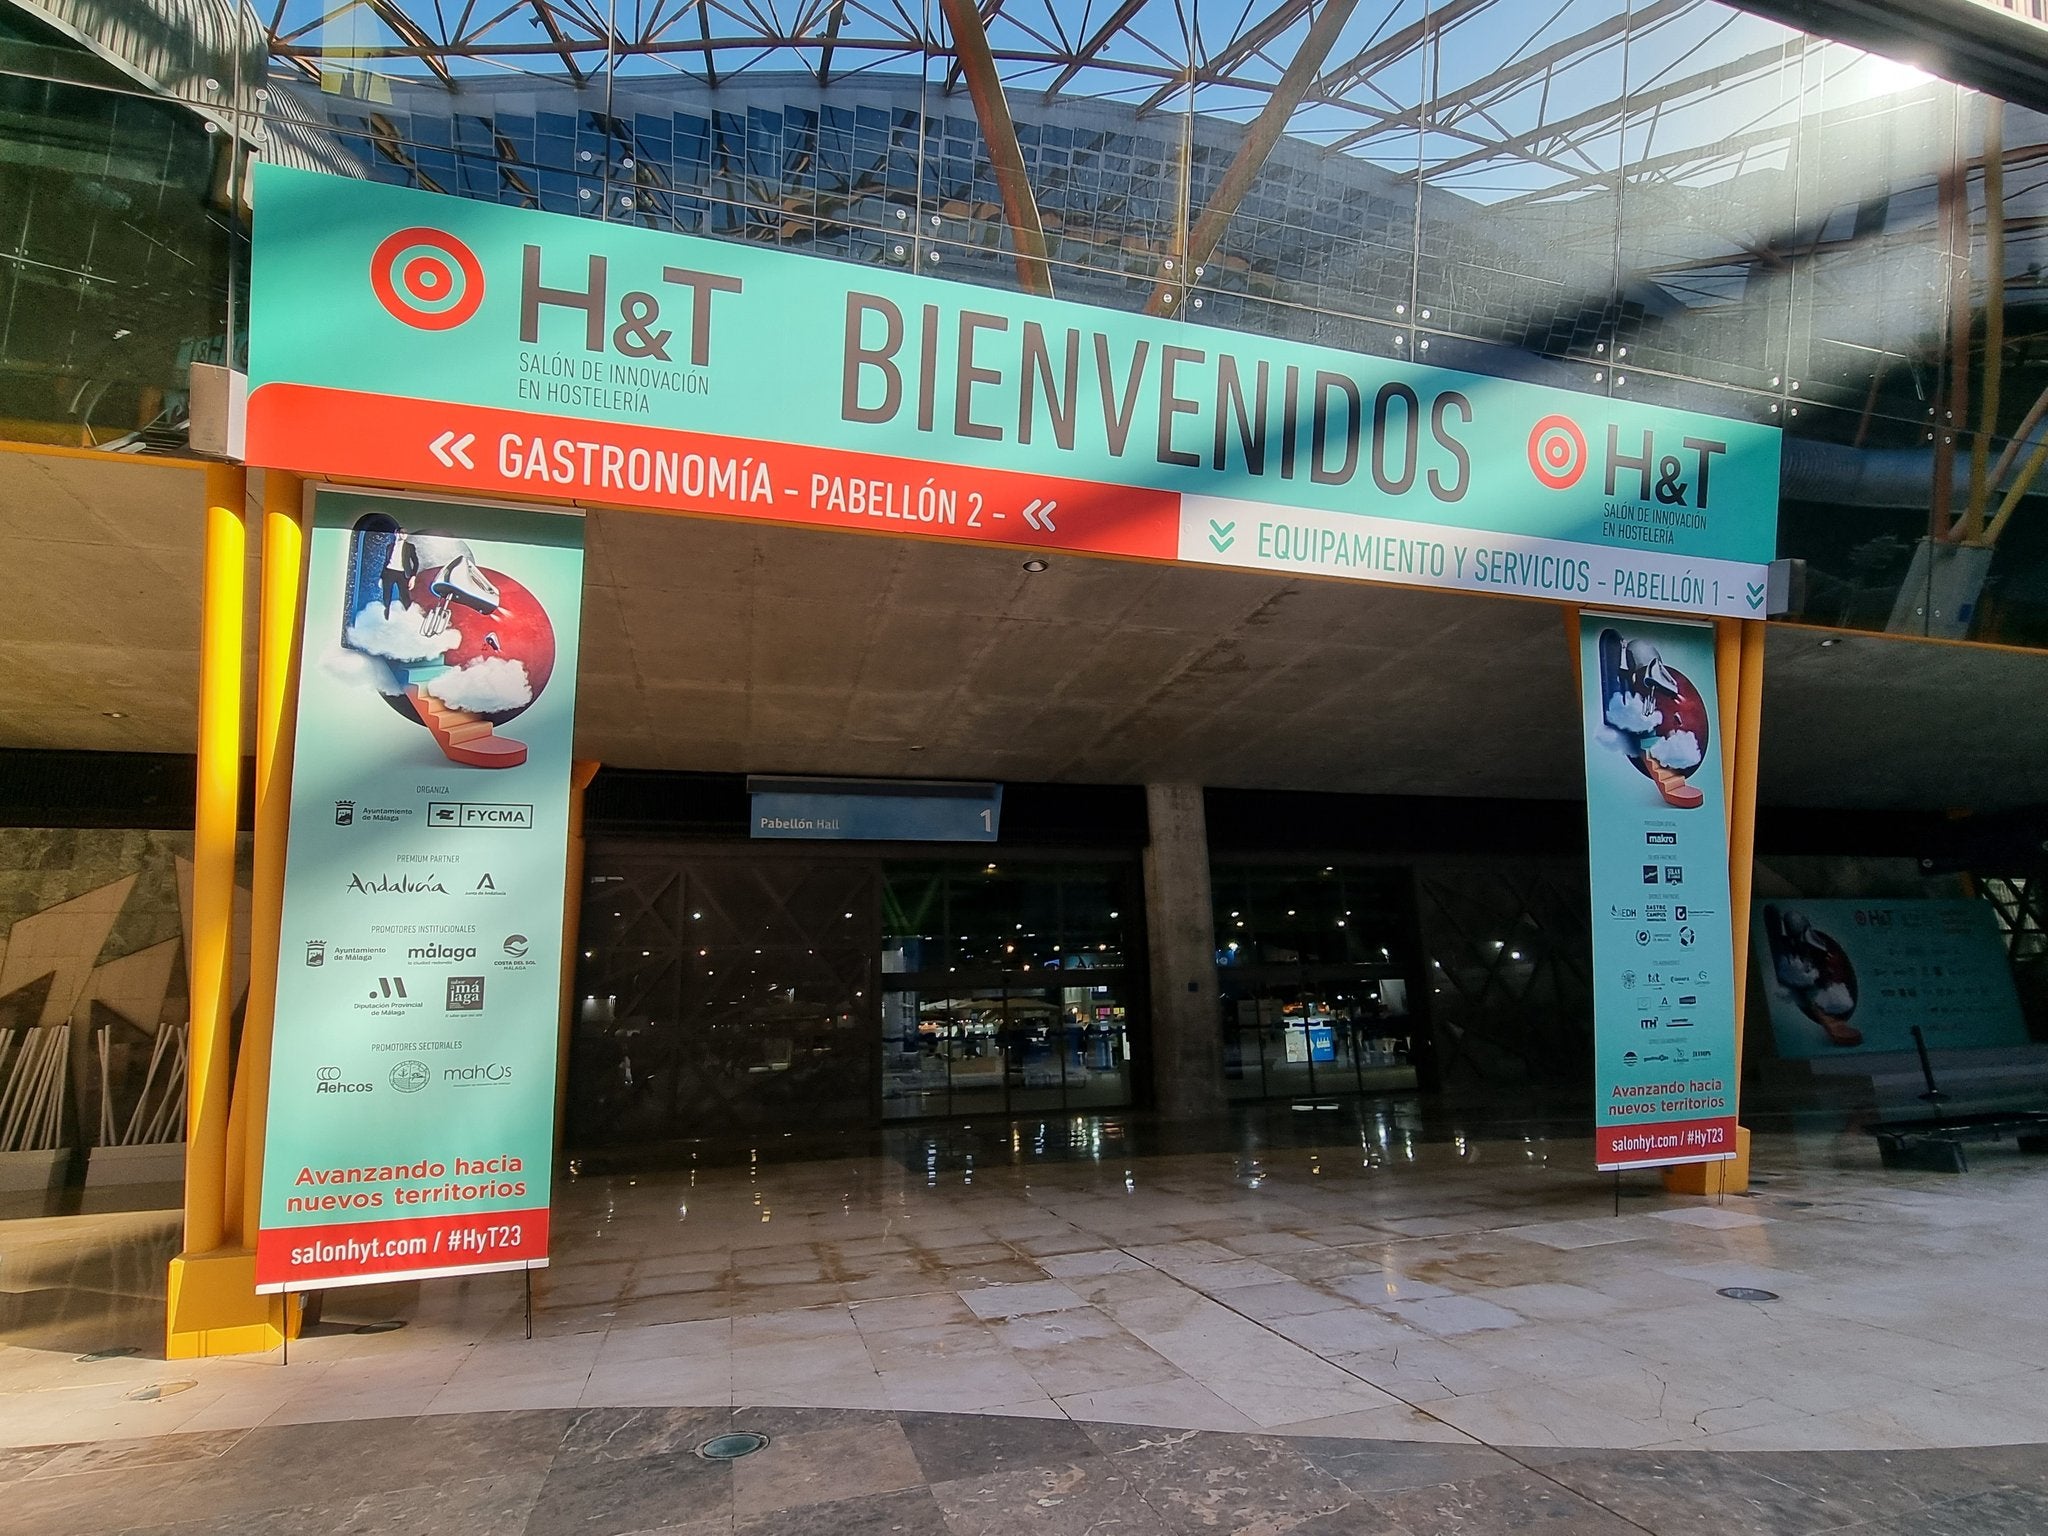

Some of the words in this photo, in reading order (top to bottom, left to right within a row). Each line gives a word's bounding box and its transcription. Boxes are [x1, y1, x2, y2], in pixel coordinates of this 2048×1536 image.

[518, 243, 744, 368] H&T
[518, 352, 575, 379] SALÓN
[582, 359, 603, 382] DE
[608, 362, 711, 397] INNOVACIÓN
[517, 378, 541, 401] EN
[545, 382, 650, 415] HOSTELERÍA
[840, 290, 1473, 503] BIENVENIDOS
[1603, 423, 1727, 510] H&T
[811, 473, 957, 526] PABELLÓN
[967, 492, 983, 528] 2
[1603, 502, 1635, 521] SALÓN
[1637, 506, 1650, 523] DE
[1652, 508, 1708, 530] INNOVACIÓN
[1602, 521, 1616, 537] EN
[1617, 525, 1675, 545] HOSTELERÍA
[1257, 522, 1446, 578] EQUIPAMIENTO
[1454, 546, 1468, 579] Y
[1474, 547, 1591, 593] SERVICIOS
[1613, 569, 1705, 606] PABELLÓN
[1712, 580, 1719, 606] 1
[416, 785, 450, 795] ORGANIZA
[362, 807, 413, 816] Ayuntamiento
[372, 814, 399, 822] Málaga
[466, 809, 526, 823] FYCMA
[979, 808, 992, 833] 1
[760, 817, 813, 830] Pabellón
[816, 818, 840, 830] Hall
[1648, 834, 1674, 844] makro
[396, 854, 429, 864] PREMIUM
[430, 854, 460, 864] PARTNER
[346, 872, 451, 896] Andalucía
[371, 925, 417, 934] PROMOTORES
[418, 924, 476, 934] INSTITUCIONALES
[334, 947, 387, 955] Ayuntamiento
[344, 953, 373, 962] Málaga
[391, 1001, 423, 1010] Provincial
[371, 1042, 417, 1052] PROMOTORES
[418, 1041, 463, 1051] SECTORIALES
[316, 1081, 373, 1094] Aehcos
[1611, 1081, 1685, 1098] Avanzando
[1689, 1078, 1722, 1093] hacia
[1608, 1102, 1657, 1116] nuevos
[1661, 1096, 1725, 1112] territorios
[1612, 1134, 1678, 1153] salonhyt.com
[1687, 1127, 1724, 1148] #HyT23
[294, 1159, 446, 1187] Avanzando
[455, 1154, 523, 1177] hacia
[286, 1190, 383, 1213] nuevos
[394, 1179, 527, 1206] territorios
[290, 1236, 427, 1266] salonhyt.com
[447, 1224, 522, 1255] #HyT23
